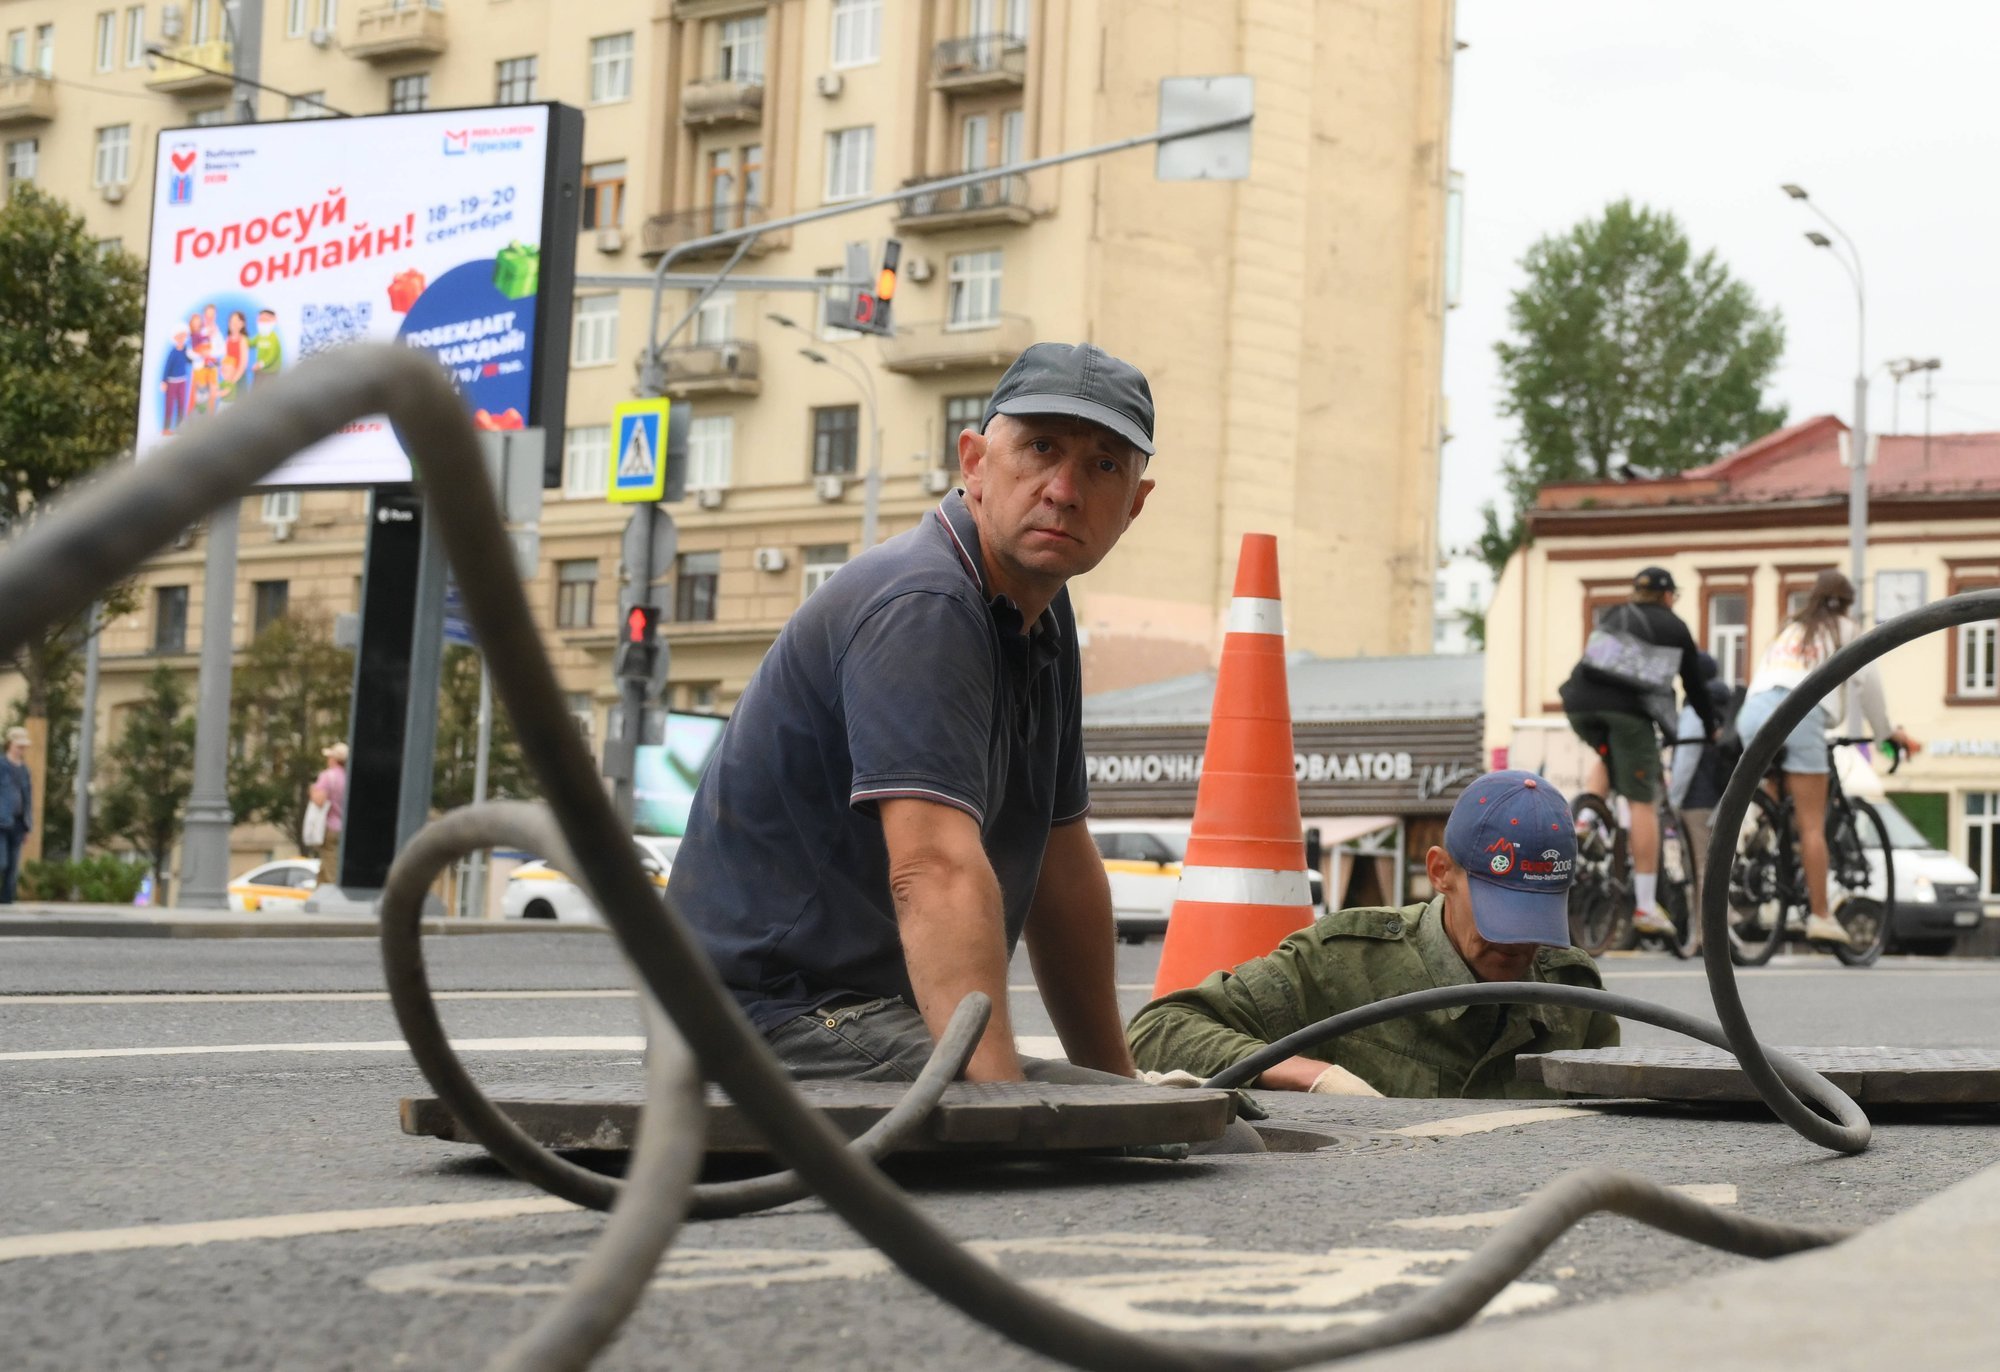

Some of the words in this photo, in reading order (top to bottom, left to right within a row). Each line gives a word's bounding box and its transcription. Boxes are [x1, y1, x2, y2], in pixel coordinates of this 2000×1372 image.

[174, 187, 347, 264] Голосуй
[426, 211, 514, 242] сентября
[239, 213, 416, 288] онлайн!
[405, 310, 517, 348] ПОБЕЖДАЕТ
[438, 328, 526, 366] КАЖДЫЙ!
[1086, 754, 1204, 783] РЮМОЧН
[1293, 751, 1413, 781] ОВЛАТОВ
